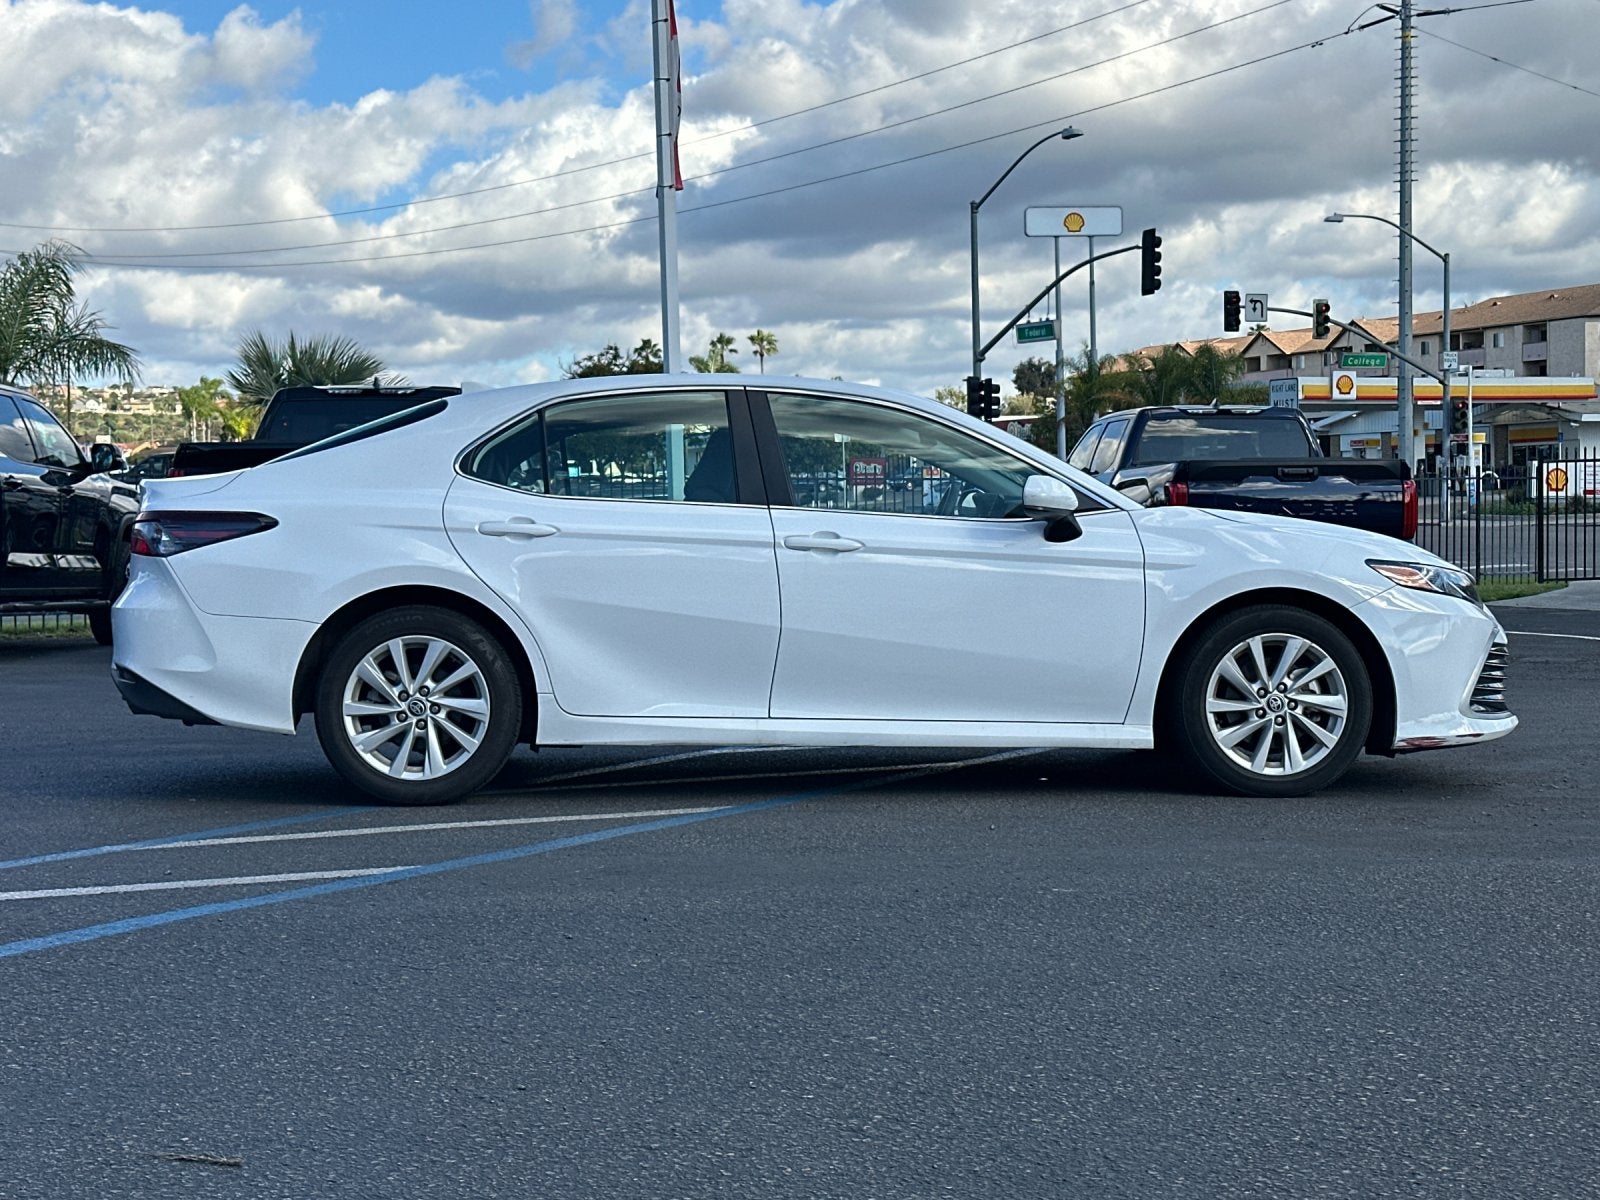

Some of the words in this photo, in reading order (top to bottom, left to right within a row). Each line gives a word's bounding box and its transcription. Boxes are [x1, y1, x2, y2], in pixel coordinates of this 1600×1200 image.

[1025, 327, 1047, 337] Federal
[1347, 357, 1380, 366] College
[1272, 384, 1284, 393] RIGHT
[1285, 383, 1296, 392] LANE
